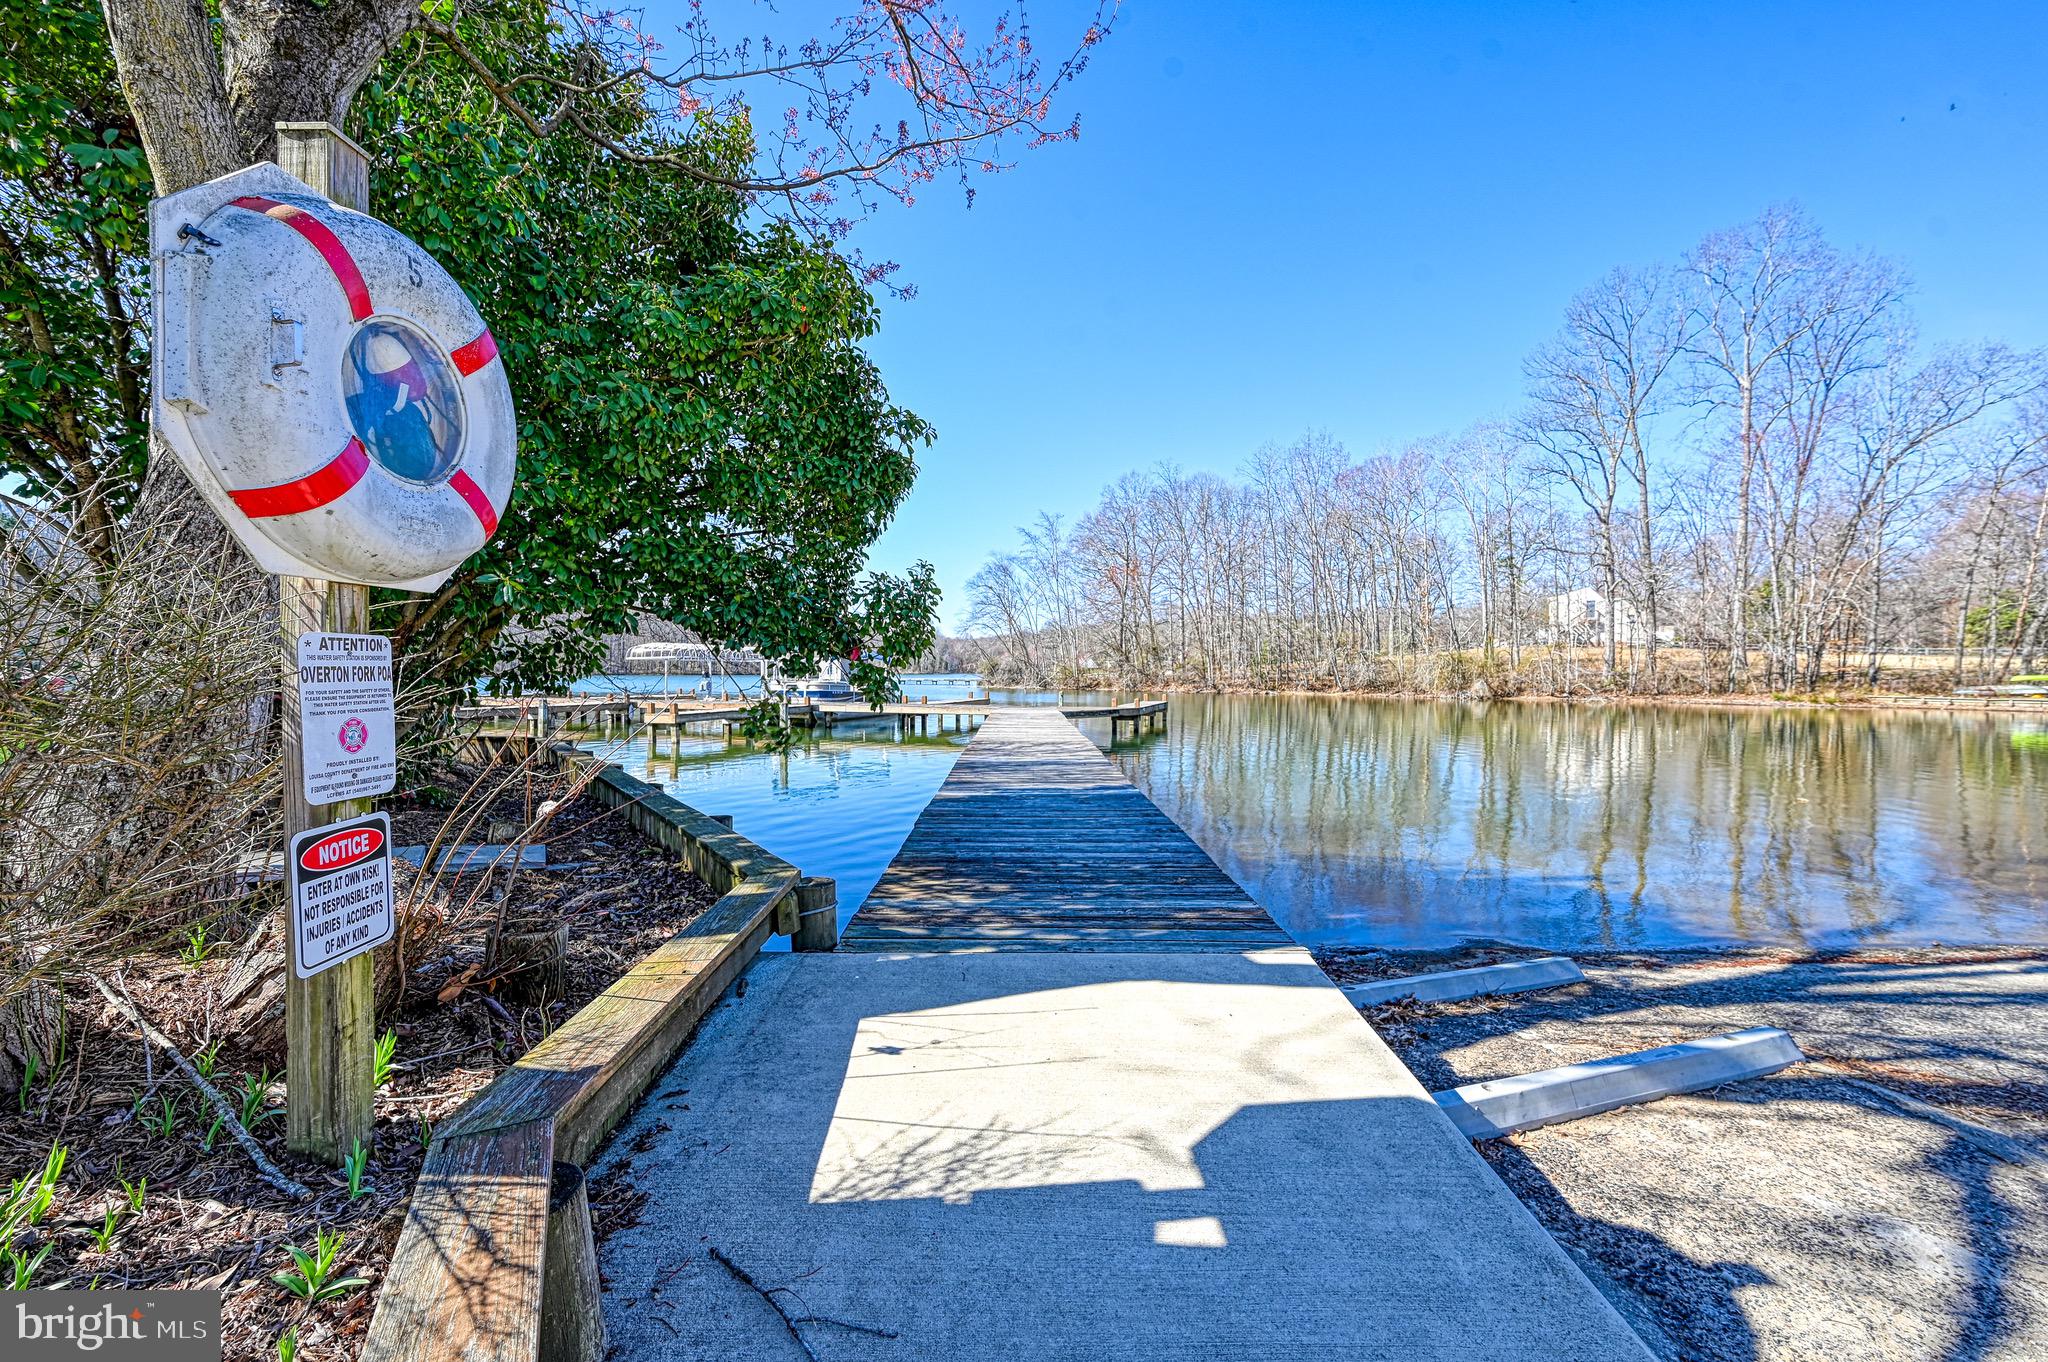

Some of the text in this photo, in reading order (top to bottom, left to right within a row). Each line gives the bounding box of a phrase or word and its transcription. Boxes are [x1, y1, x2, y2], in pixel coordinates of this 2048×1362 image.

[407, 255, 423, 288] 5
[319, 637, 382, 652] ATTENTION
[301, 666, 392, 683] OVERTON FORK POA
[341, 767, 364, 775] DEPARTMENT
[319, 833, 369, 865] NOTICE
[308, 864, 379, 900] ENTER AT OWN RISK!
[304, 881, 384, 922] NOT RESPONSIBLE FOR
[307, 917, 340, 942] INJURIES
[346, 900, 383, 926] ACCIDENTS
[326, 925, 369, 954] OF ANY KIND
